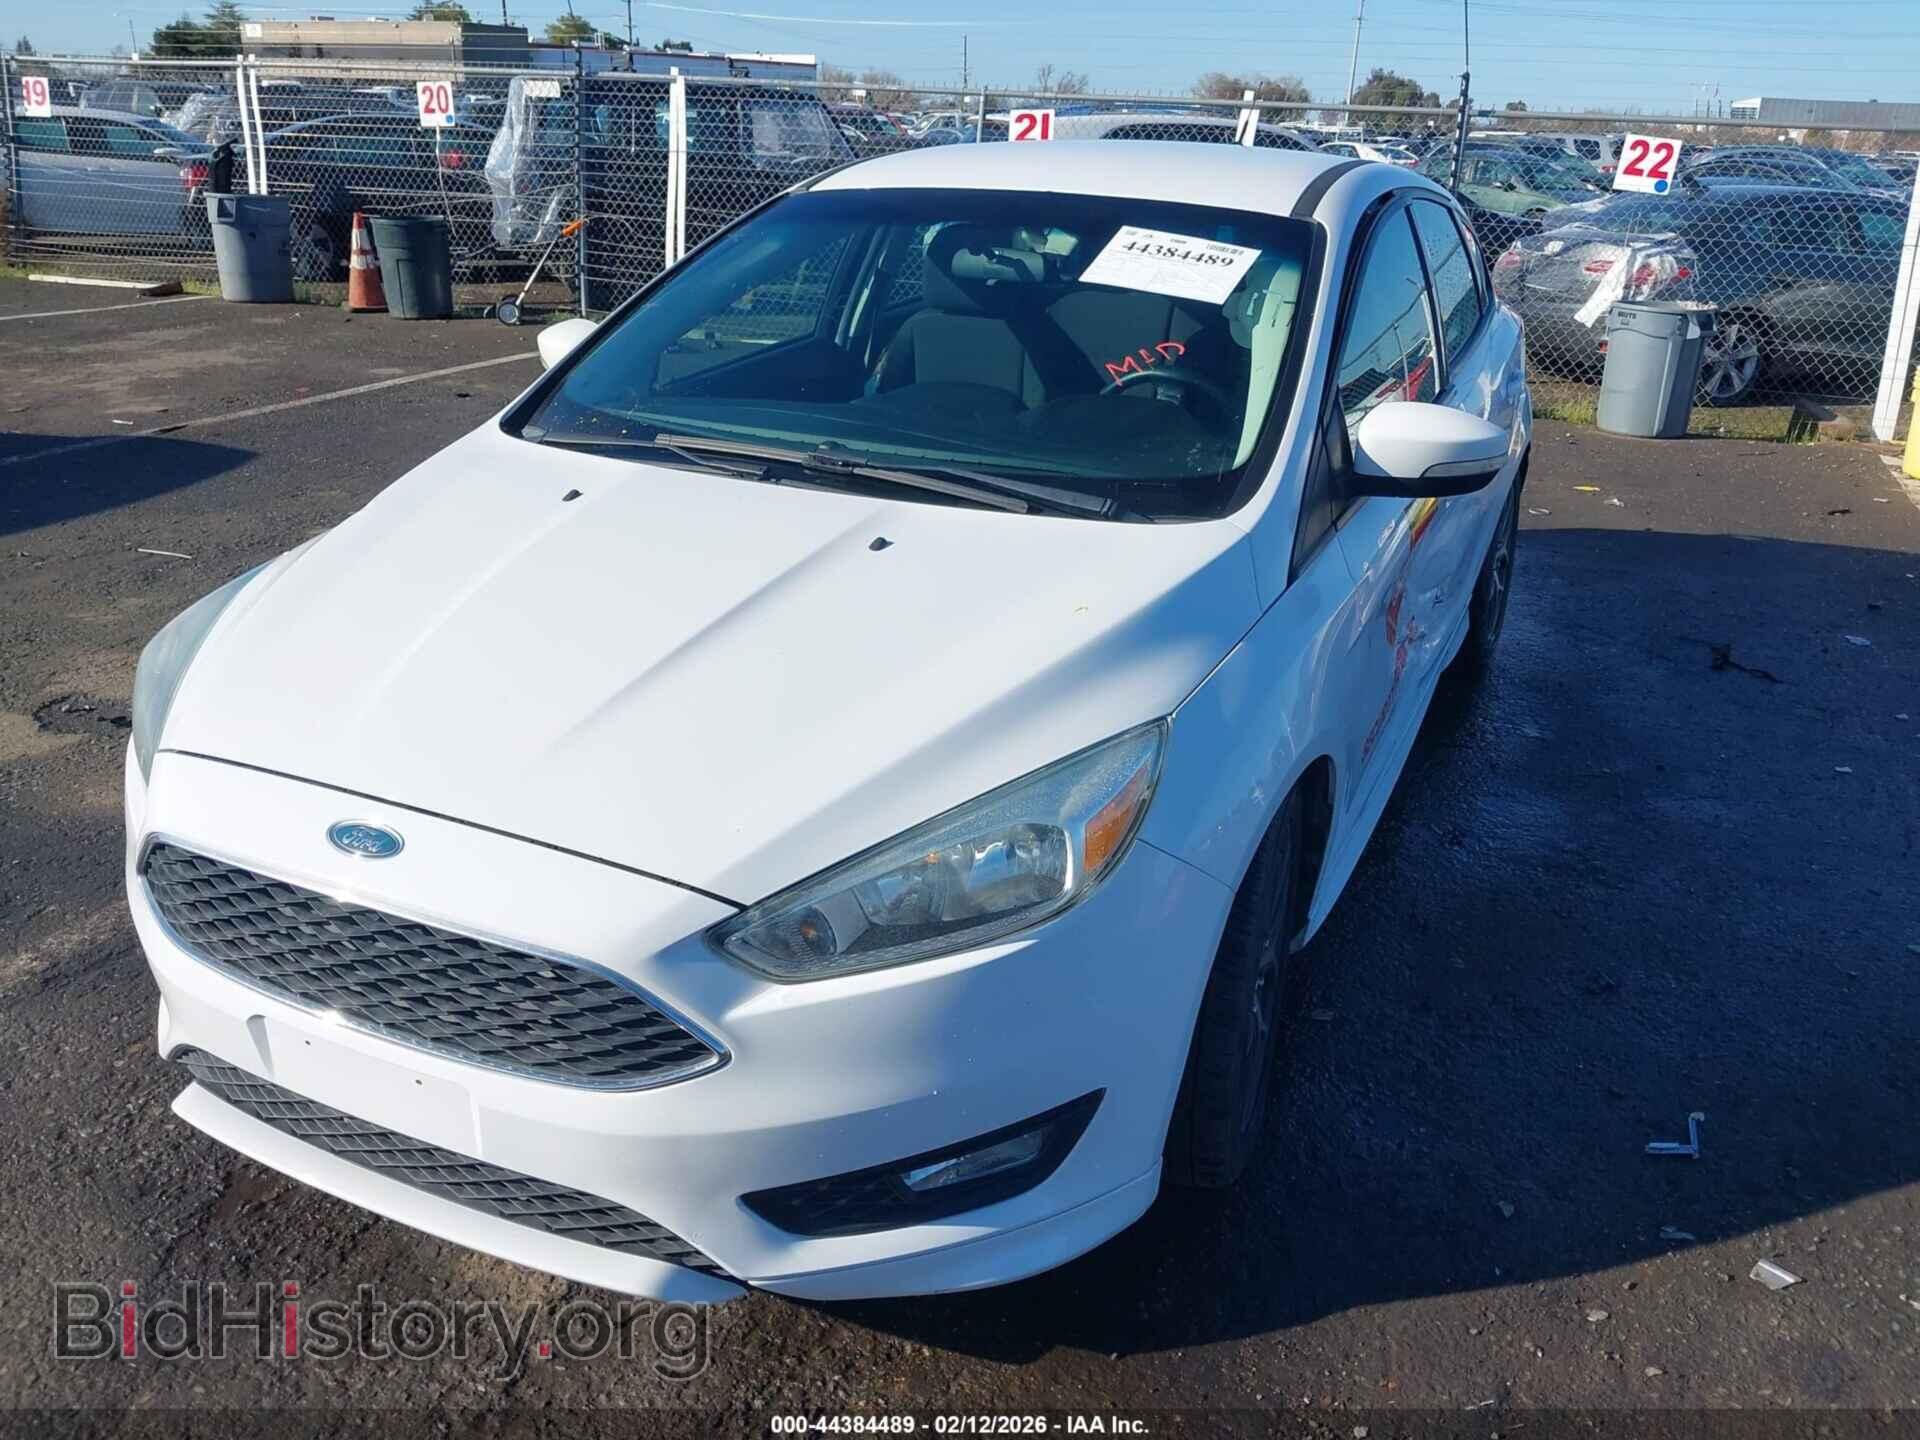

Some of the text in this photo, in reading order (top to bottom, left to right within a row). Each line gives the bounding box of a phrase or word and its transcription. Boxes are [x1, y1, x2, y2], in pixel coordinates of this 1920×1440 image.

[24, 79, 47, 106] 19
[421, 85, 449, 114] 20
[1014, 112, 1050, 141] 21
[1622, 139, 1674, 180] 22
[1122, 240, 1235, 267] 44384489
[341, 828, 386, 853] Ford
